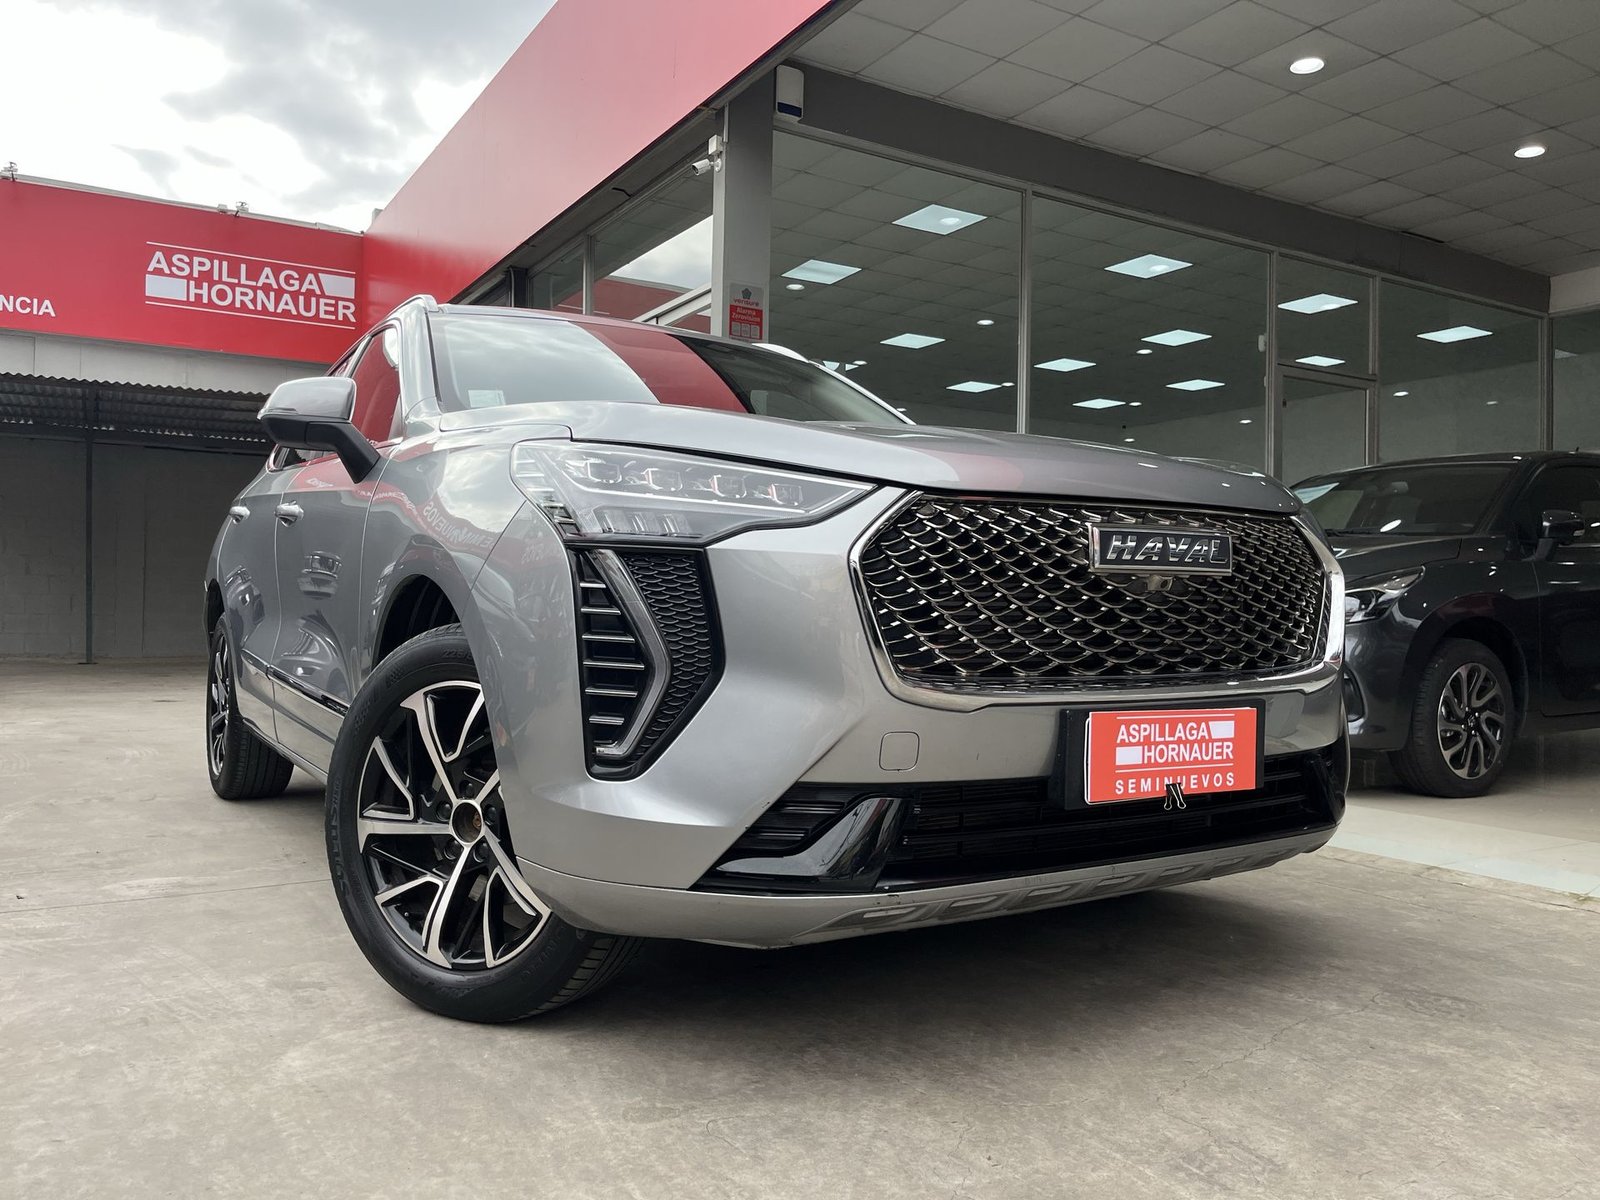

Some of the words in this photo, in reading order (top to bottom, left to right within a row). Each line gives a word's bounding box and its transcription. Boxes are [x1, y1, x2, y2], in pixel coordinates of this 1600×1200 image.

[147, 251, 322, 295] ASPILLAGA
[189, 280, 356, 323] HORNAUER
[1107, 534, 1229, 564] HAVAL
[1116, 721, 1209, 744] ASPILLAGA
[1144, 741, 1234, 764] HORNAUER
[1115, 772, 1235, 795] SEMINUEVOS
